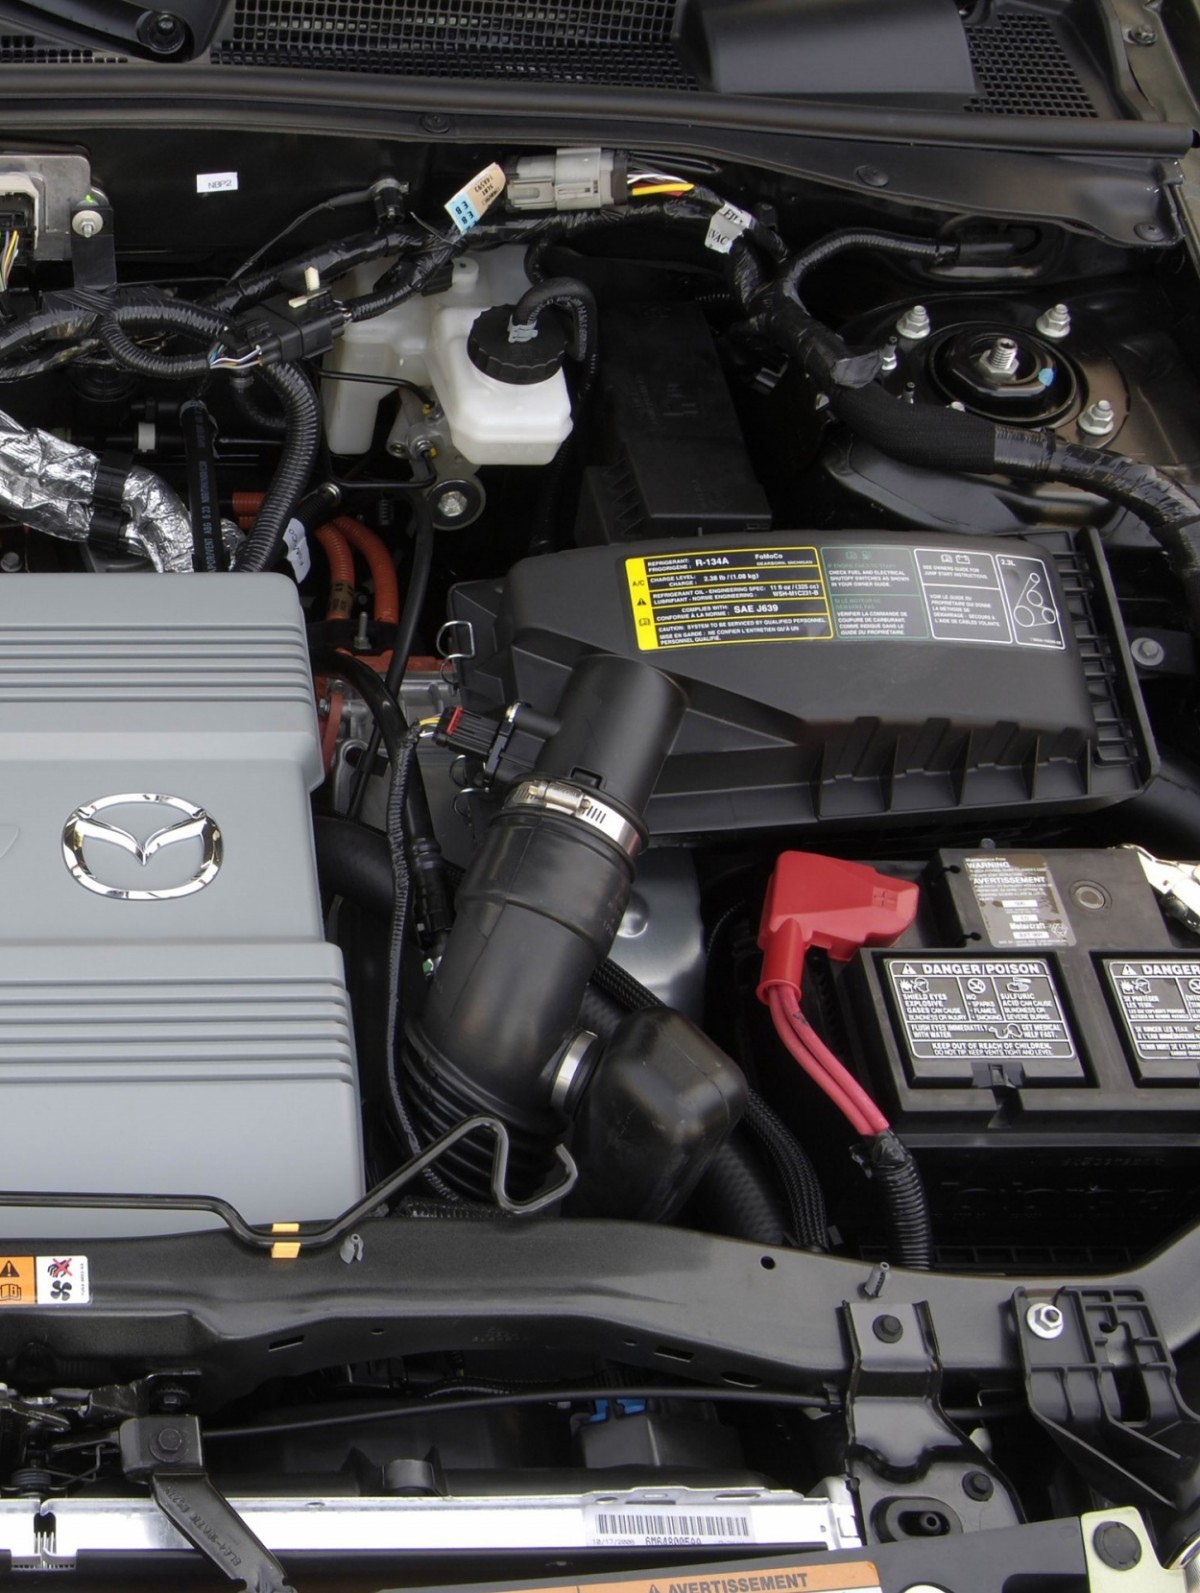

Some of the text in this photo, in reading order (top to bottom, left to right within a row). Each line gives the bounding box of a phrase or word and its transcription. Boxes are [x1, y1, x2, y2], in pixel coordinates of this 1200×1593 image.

[695, 557, 729, 567] R-134A
[734, 605, 754, 613] SAE
[668, 1573, 807, 1593] AVERTISSEMENT
